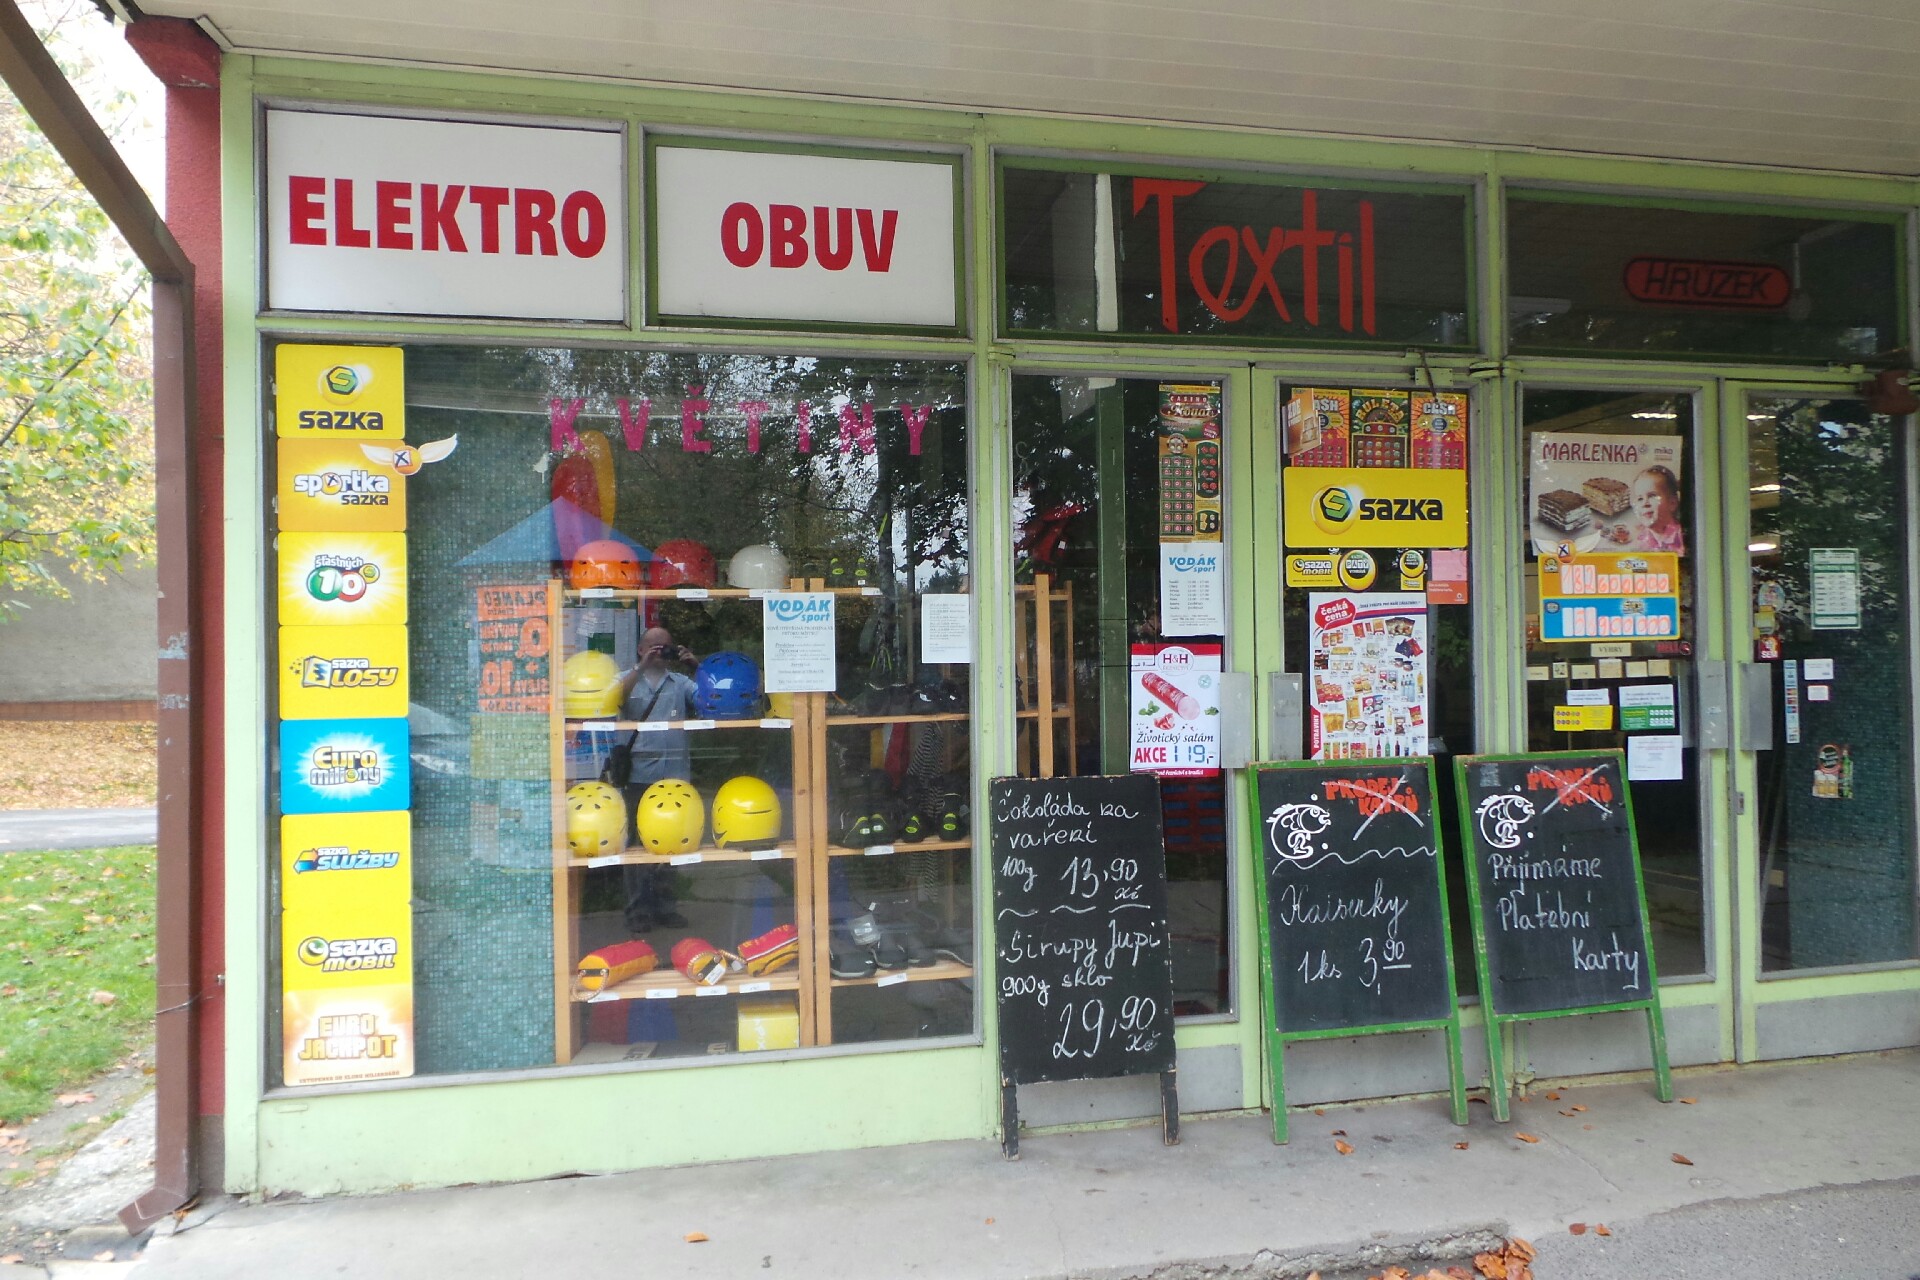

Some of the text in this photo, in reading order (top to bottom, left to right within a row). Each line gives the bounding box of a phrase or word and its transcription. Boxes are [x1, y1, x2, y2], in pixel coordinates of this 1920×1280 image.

[288, 175, 607, 259] ELEKTRO
[720, 201, 899, 273] OBUV
[1132, 177, 1377, 336] Textil
[298, 409, 384, 431] sazka
[549, 384, 934, 456] KVĚTINY
[1542, 442, 1638, 463] MARLENKA
[293, 470, 390, 498] sportka
[340, 493, 389, 506] sazka
[1359, 498, 1444, 521] sazka
[1168, 554, 1217, 566] VODÁK
[1193, 566, 1216, 574] sport
[767, 596, 832, 613] VODÁK
[1320, 599, 1349, 616] česká
[801, 612, 831, 624] sport
[1325, 610, 1349, 622] cena
[331, 658, 370, 669] sazka
[1163, 653, 1189, 664] H&H
[331, 667, 400, 688] LOSY
[1182, 732, 1214, 743] salám
[312, 746, 378, 770] Euro
[1134, 746, 1167, 764] AKCE
[309, 766, 381, 786] miliony
[1324, 777, 1399, 801] PRODEJ
[1009, 819, 1098, 849] vaření
[316, 850, 399, 872] SLUŽBY
[317, 846, 349, 856] sazka
[1059, 856, 1138, 898] 13,90
[1280, 877, 1409, 942] Kaiserky
[328, 937, 398, 957] sazka
[1005, 919, 1161, 974] Sirupy Jupi
[321, 954, 396, 972] MOBIL
[1571, 932, 1639, 990] Karty
[1002, 964, 1113, 1007] 900g sklo
[318, 1014, 375, 1037] EURO
[1052, 995, 1157, 1060] 29,90
[298, 1035, 398, 1061] JACKPOT
